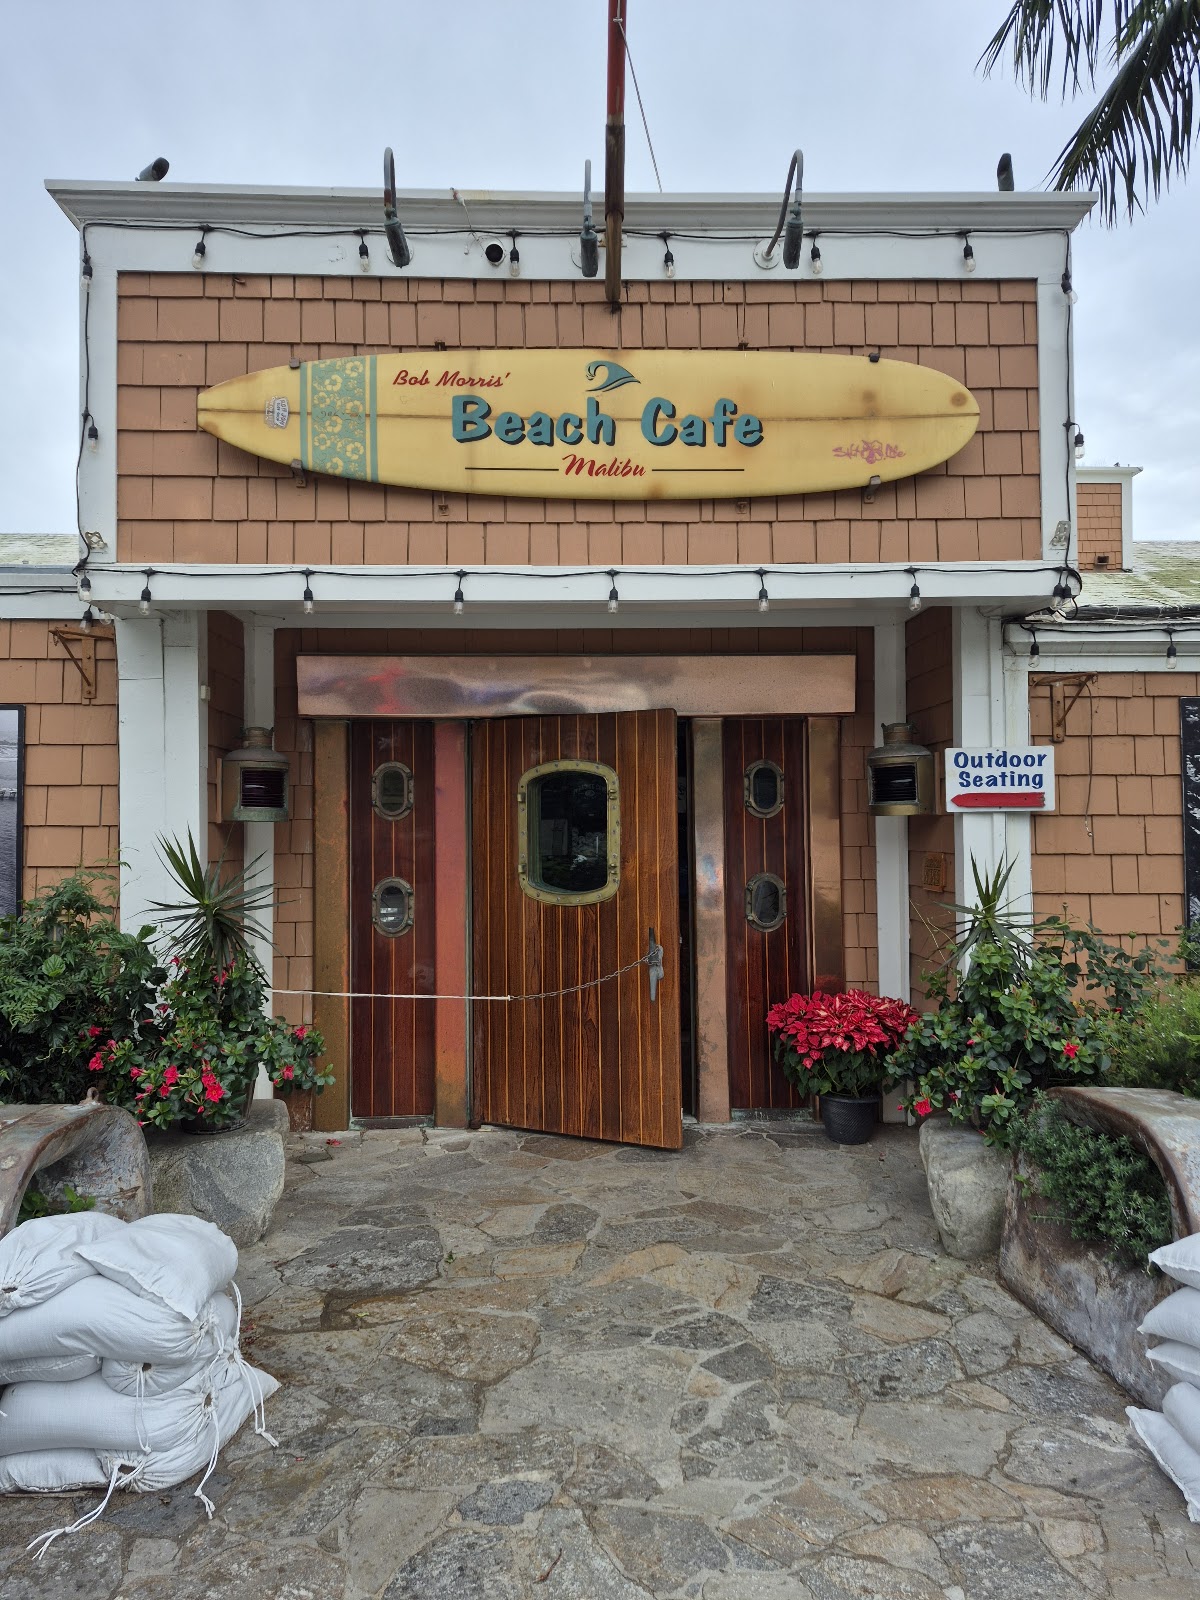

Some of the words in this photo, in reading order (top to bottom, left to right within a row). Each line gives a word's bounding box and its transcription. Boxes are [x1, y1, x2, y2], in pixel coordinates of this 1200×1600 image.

[392, 369, 430, 386] Bob
[435, 370, 511, 388] Morris'
[451, 394, 616, 447] Beach
[641, 396, 764, 448] Cafe
[561, 453, 646, 477] Malibu
[953, 751, 1048, 769] Outdoor
[958, 770, 1044, 790] Seating
